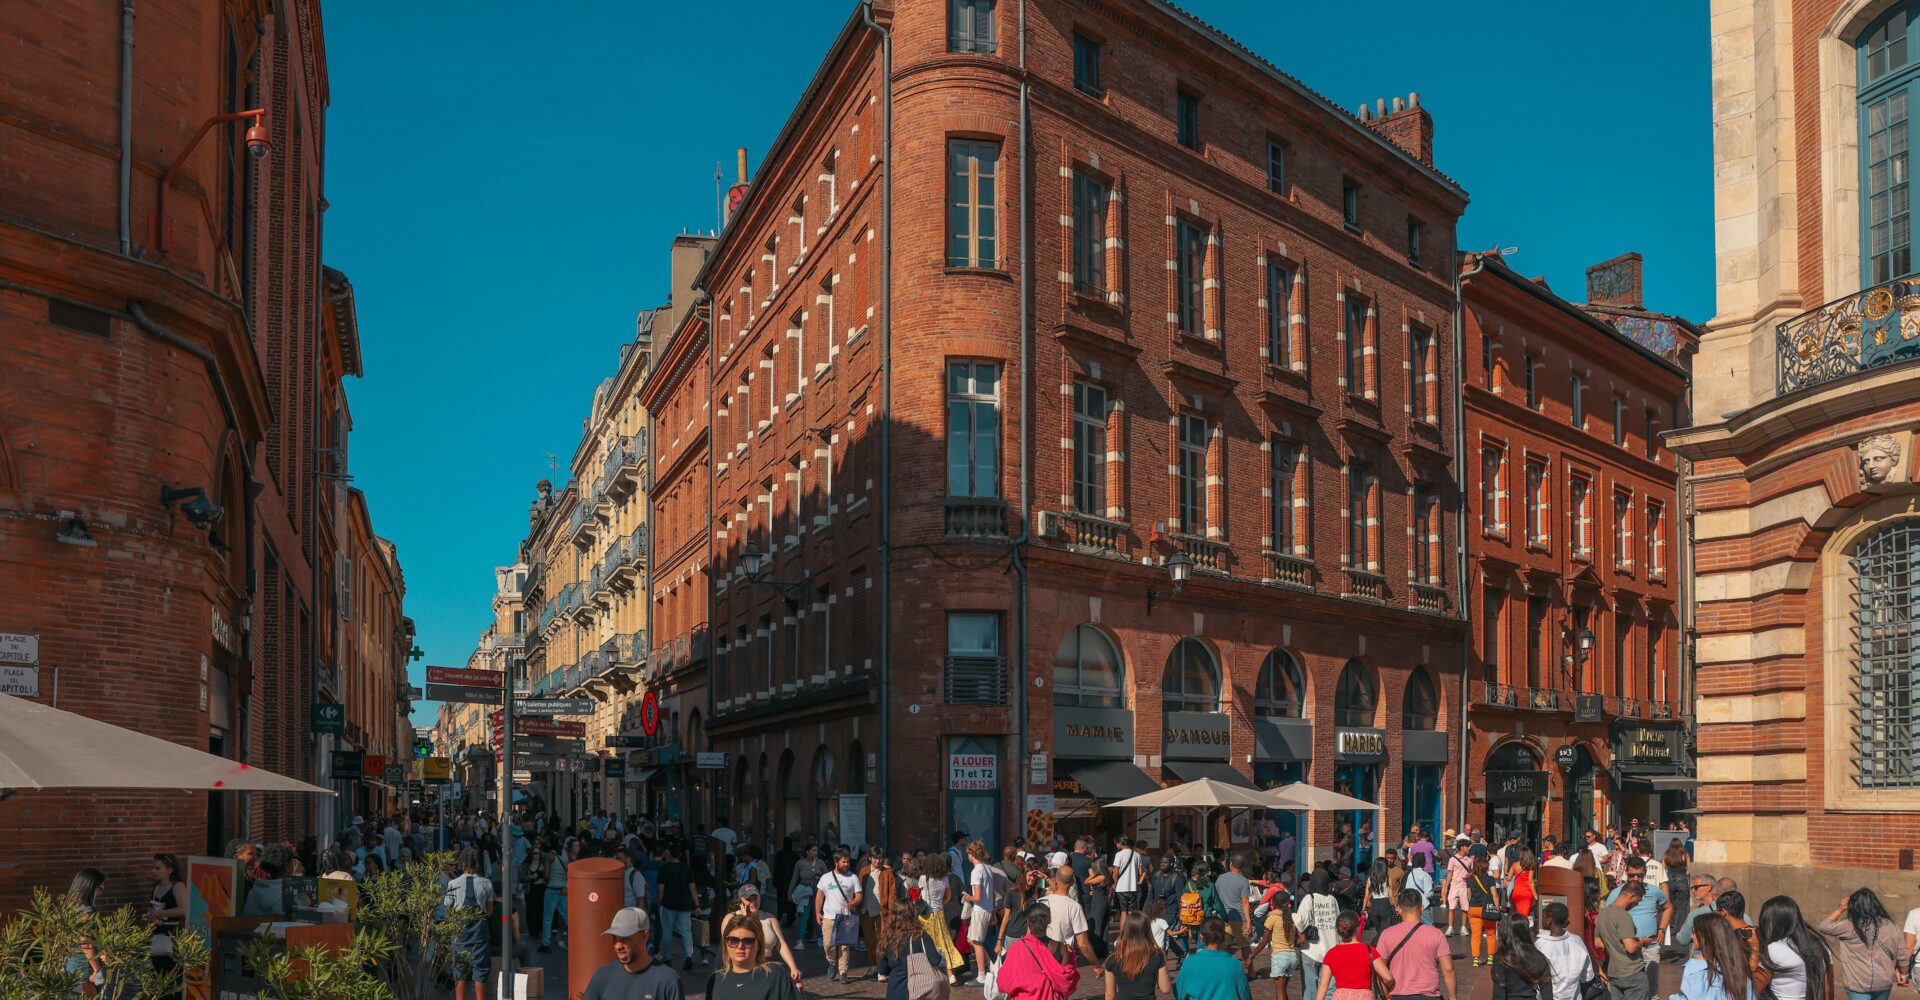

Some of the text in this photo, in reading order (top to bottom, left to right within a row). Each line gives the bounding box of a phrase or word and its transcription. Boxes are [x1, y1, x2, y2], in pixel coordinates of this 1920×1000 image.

[0, 684, 32, 694] APITOLI
[527, 700, 547, 708] toilettes
[1067, 725, 1123, 740] MAMIE
[1164, 727, 1230, 744] D'AMOUR
[1340, 732, 1384, 755] HARIBO
[952, 756, 994, 766] A LOUER
[953, 769, 993, 778] T1 et T2
